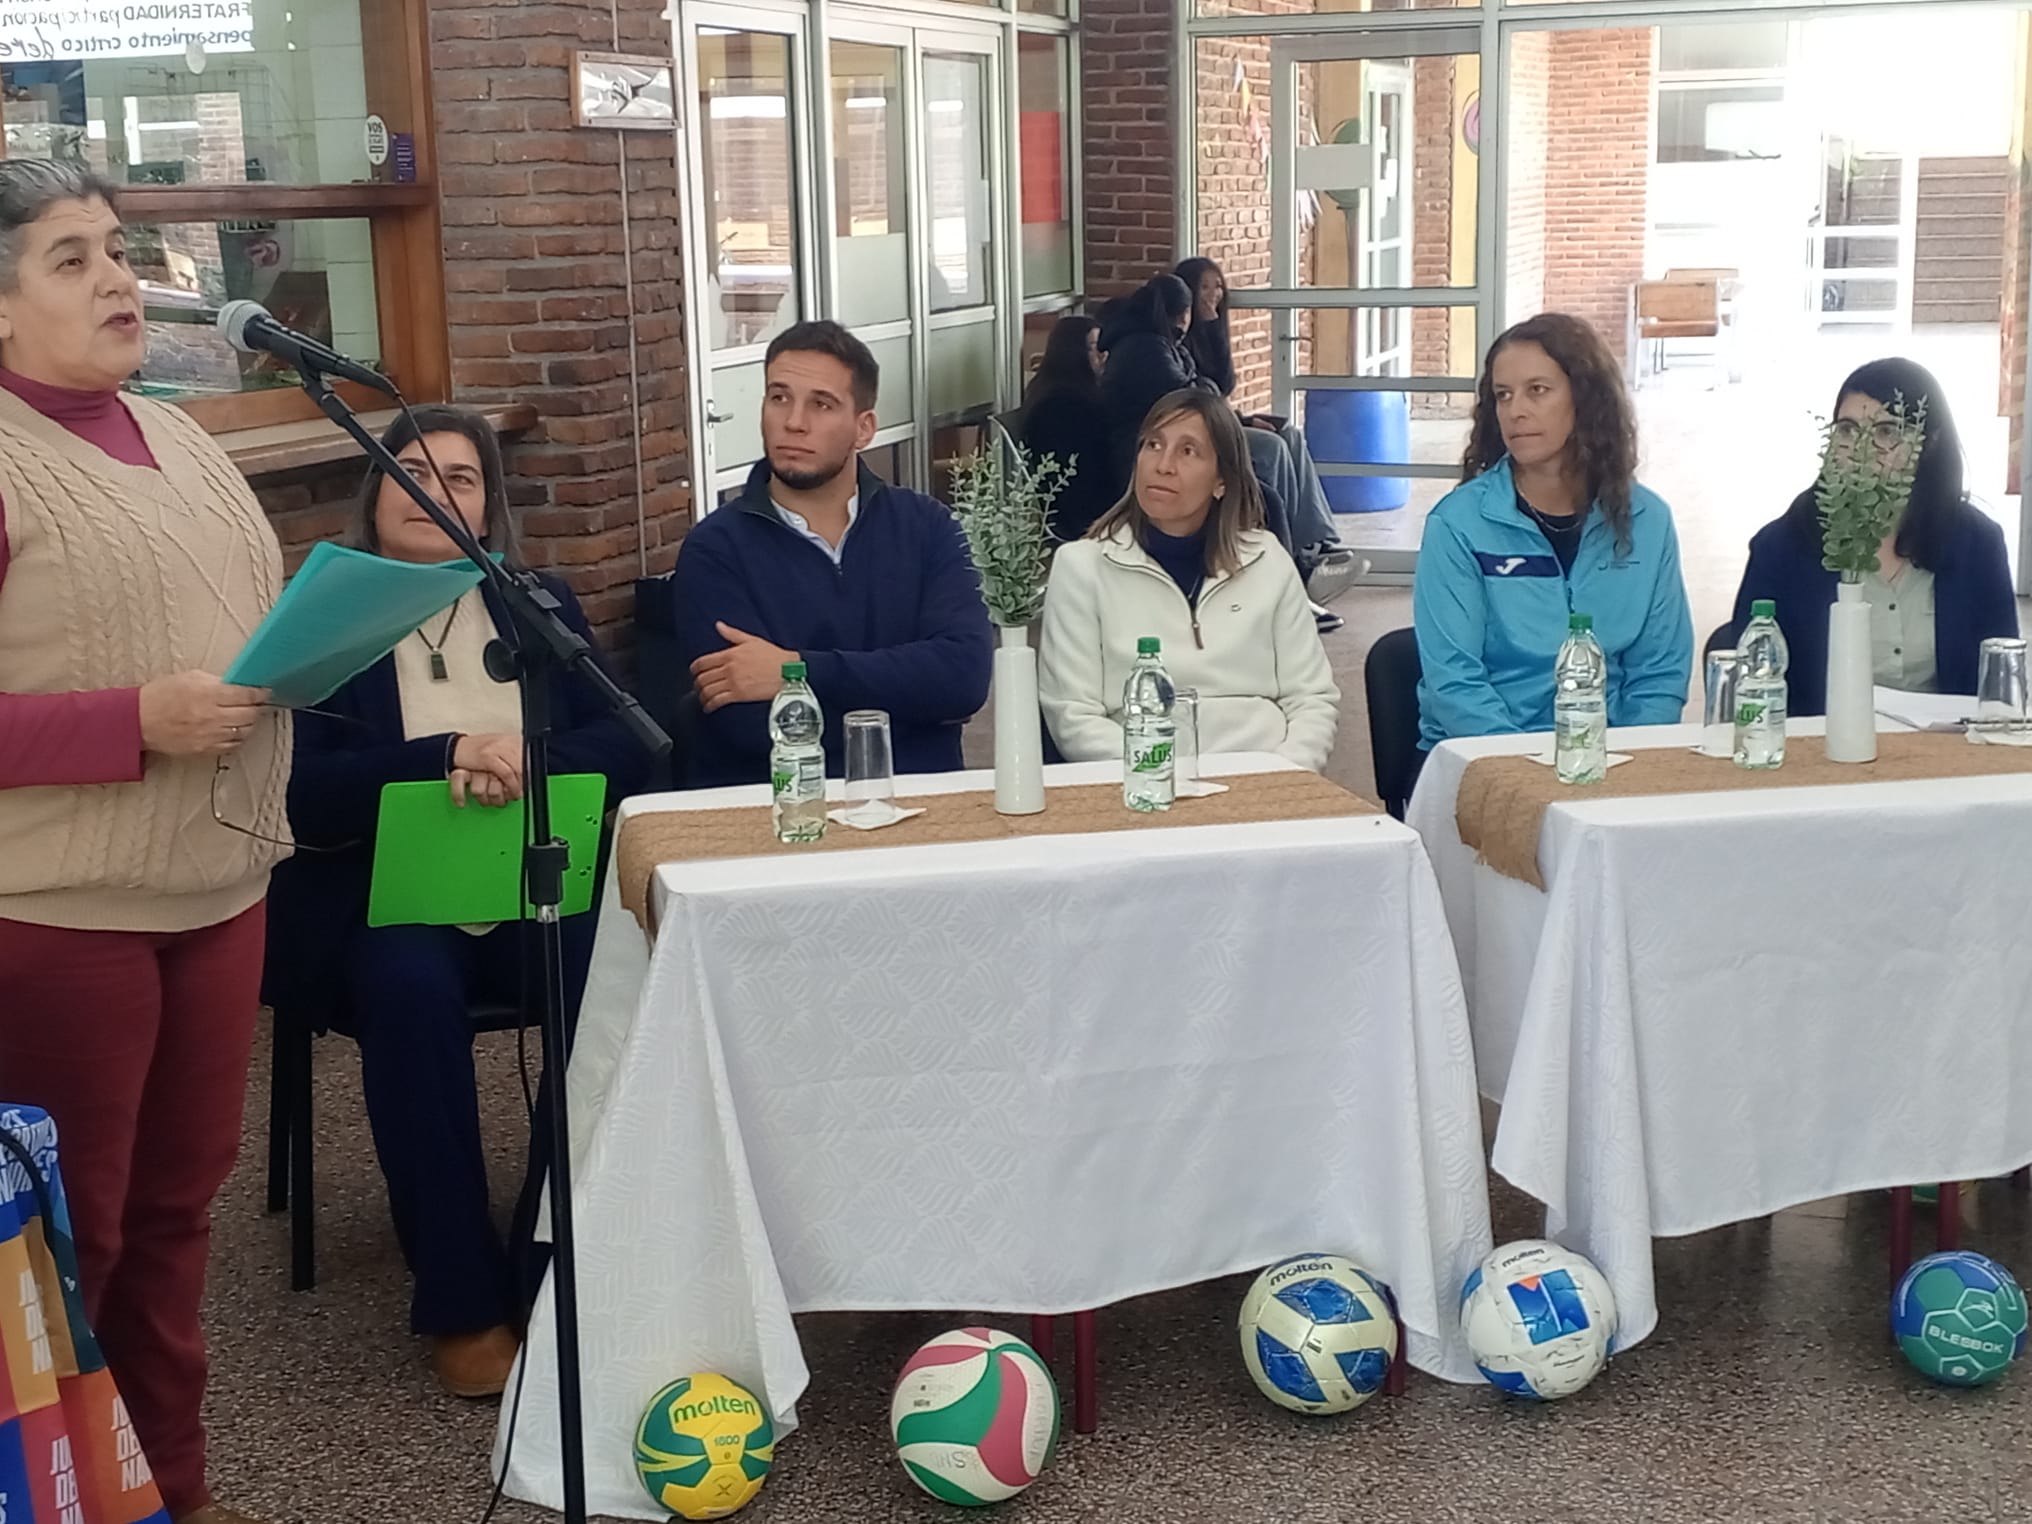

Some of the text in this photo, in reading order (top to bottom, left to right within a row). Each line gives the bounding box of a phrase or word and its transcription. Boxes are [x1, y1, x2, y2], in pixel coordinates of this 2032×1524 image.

[1133, 748, 1173, 764] SALUS
[1270, 1262, 1334, 1286] molten
[673, 1395, 757, 1423] molten
